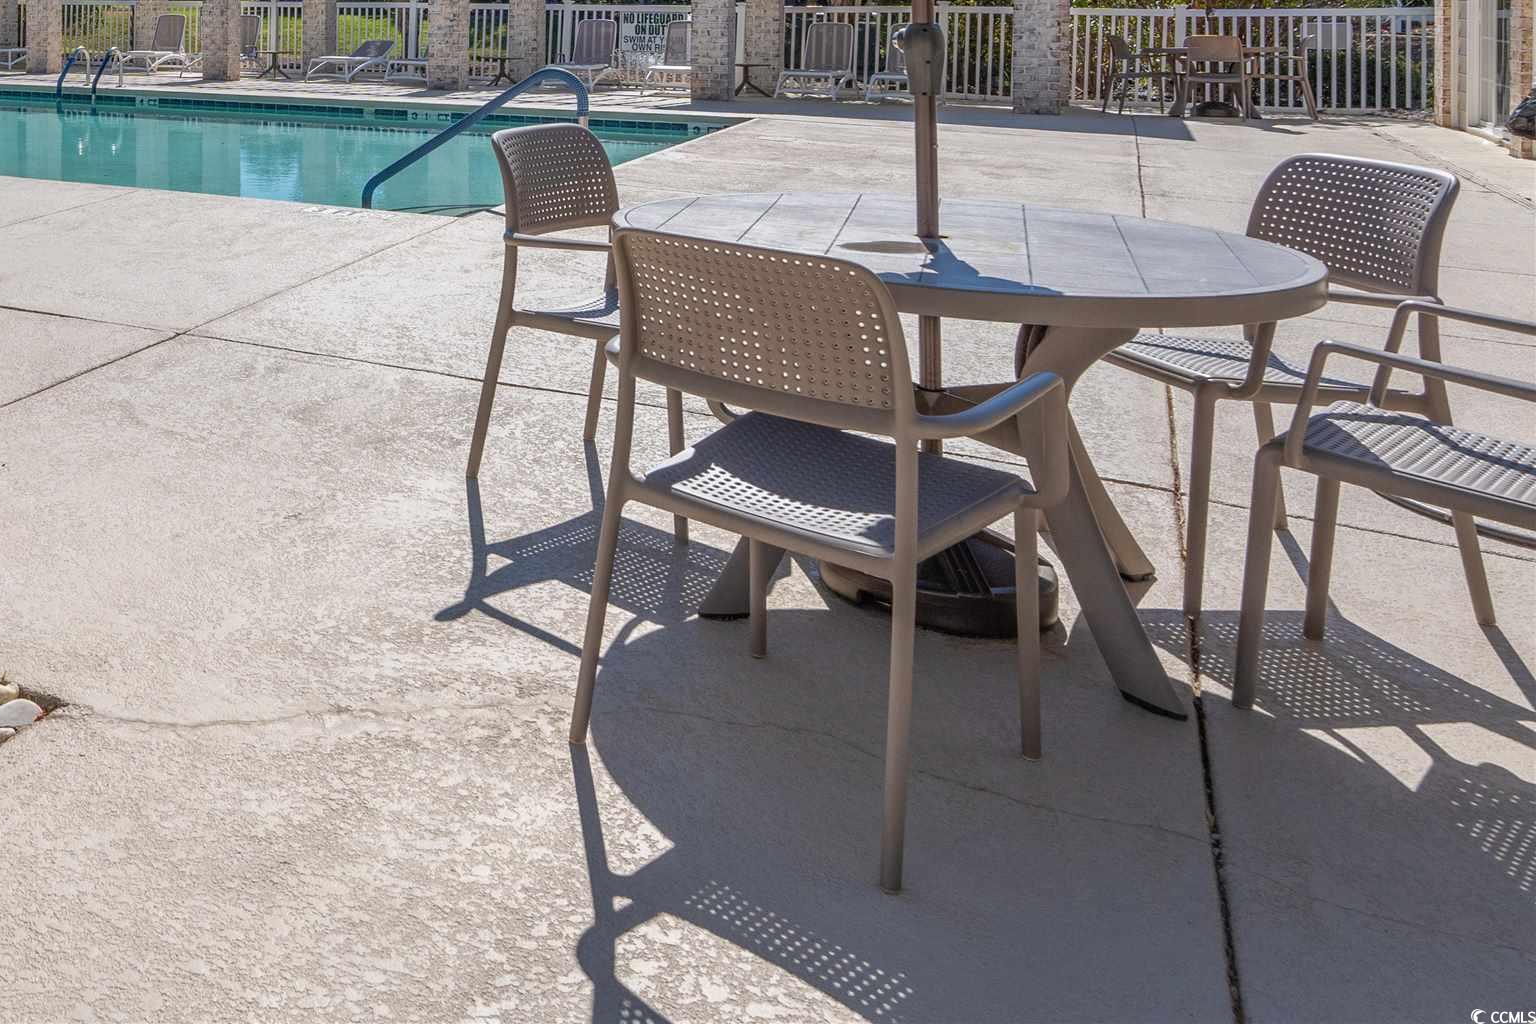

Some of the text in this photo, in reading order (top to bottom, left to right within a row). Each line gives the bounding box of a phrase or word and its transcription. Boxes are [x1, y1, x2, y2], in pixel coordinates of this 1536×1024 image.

[624, 13, 684, 24] NO LIFEGUARD
[635, 24, 668, 35] ON DUT
